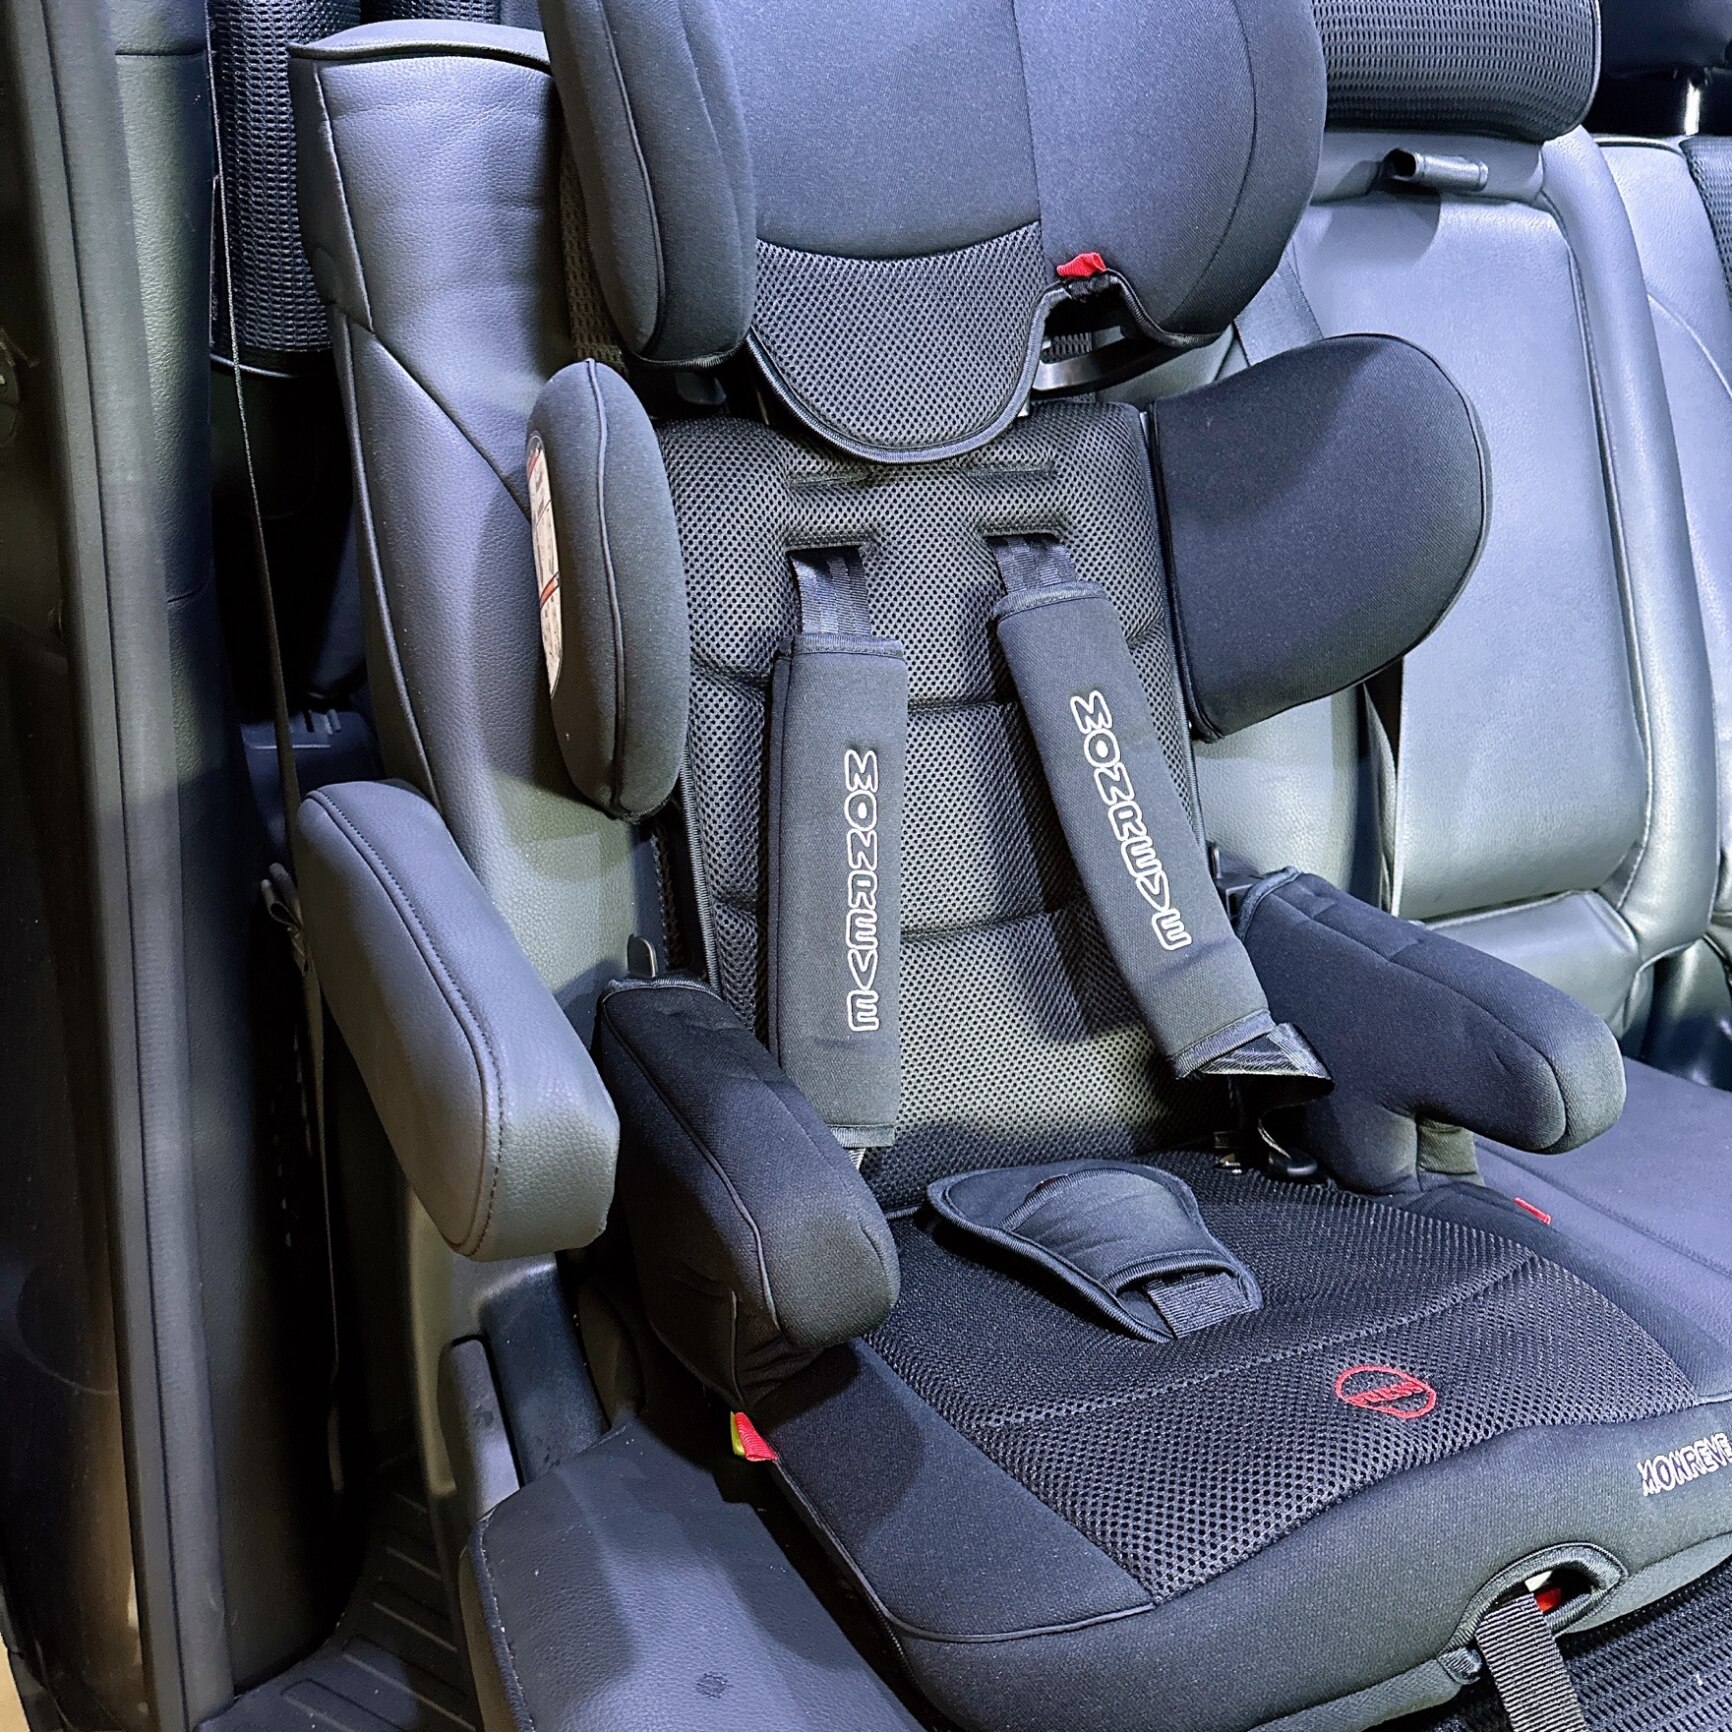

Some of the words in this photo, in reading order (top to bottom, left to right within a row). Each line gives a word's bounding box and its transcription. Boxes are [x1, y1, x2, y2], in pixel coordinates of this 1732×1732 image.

[843, 749, 880, 1032] MONREVE
[1070, 689, 1193, 951] MONREVE
[1636, 1432, 1732, 1497] MONREVE
